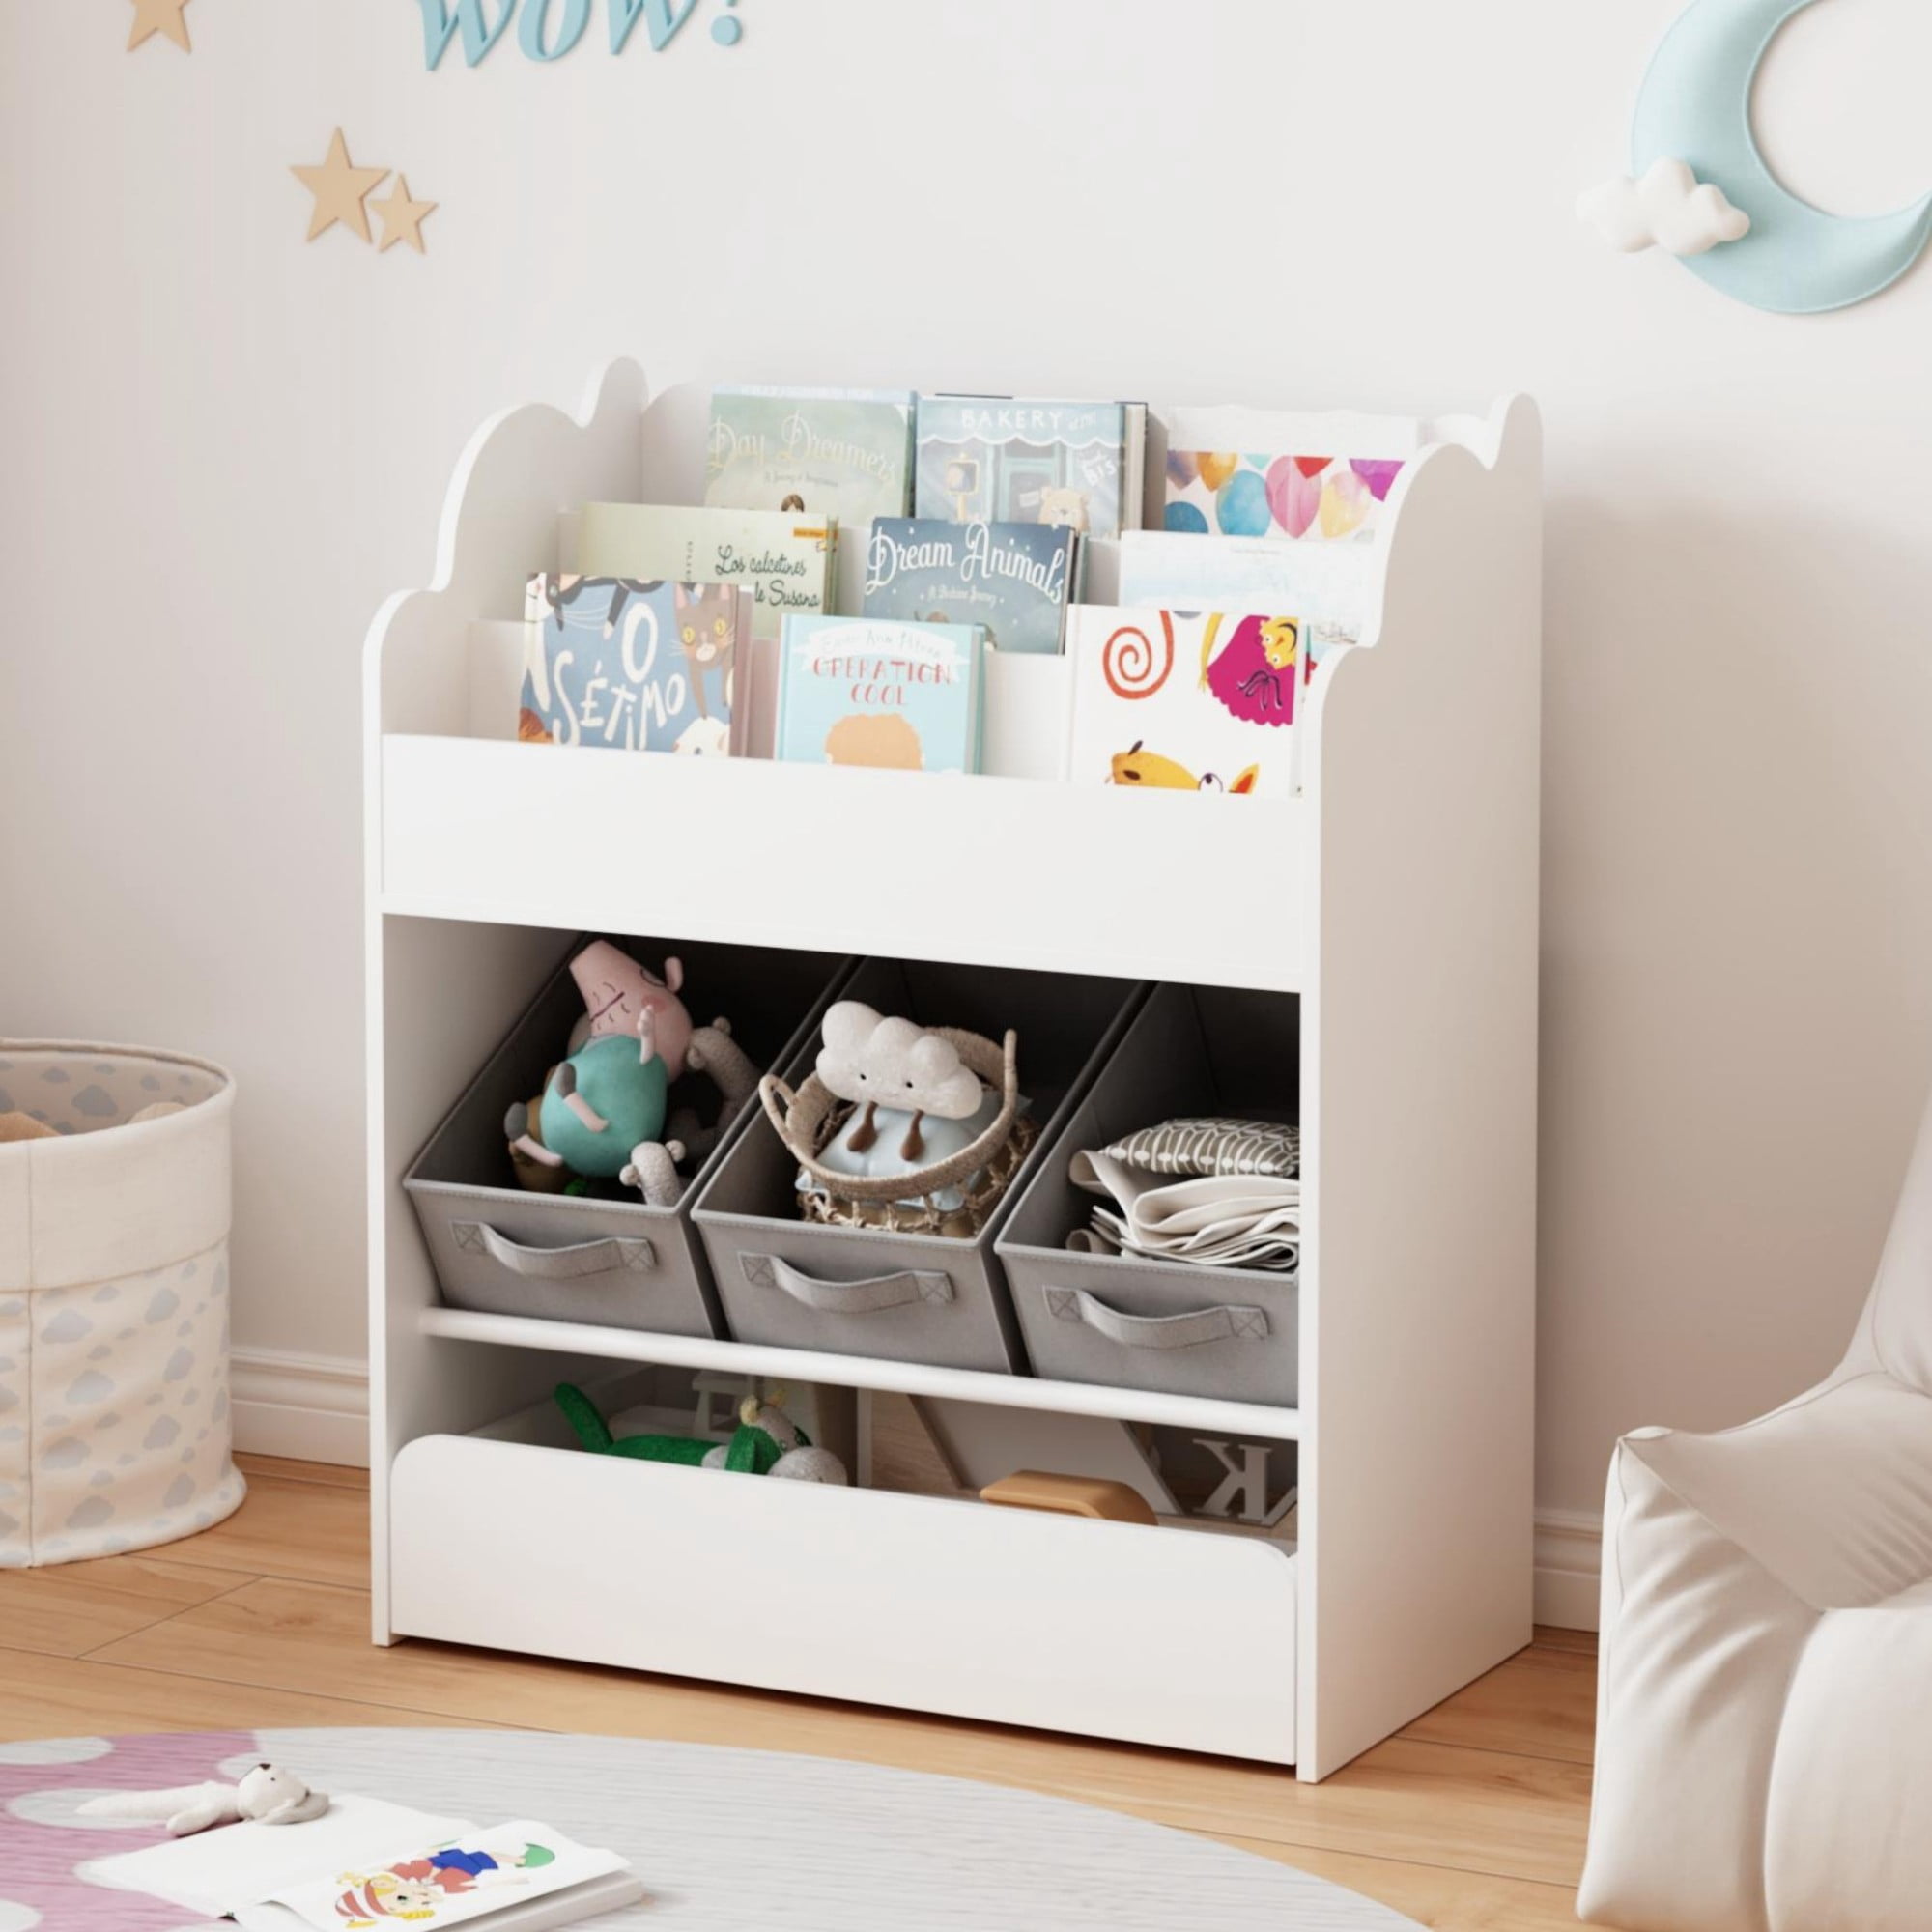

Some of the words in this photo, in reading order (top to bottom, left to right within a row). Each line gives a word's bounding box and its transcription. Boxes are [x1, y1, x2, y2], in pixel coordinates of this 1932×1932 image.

[960, 409, 1064, 430] BAKERY
[708, 413, 765, 474] Day
[778, 409, 897, 481] Dreamers
[715, 544, 747, 576] Los
[749, 550, 807, 577] calcetines
[865, 526, 955, 595] Dream
[960, 521, 1065, 605] Animals
[768, 579, 820, 608] Susana
[621, 602, 659, 684] O
[813, 657, 952, 684] OPERATION
[850, 683, 908, 707] COOL
